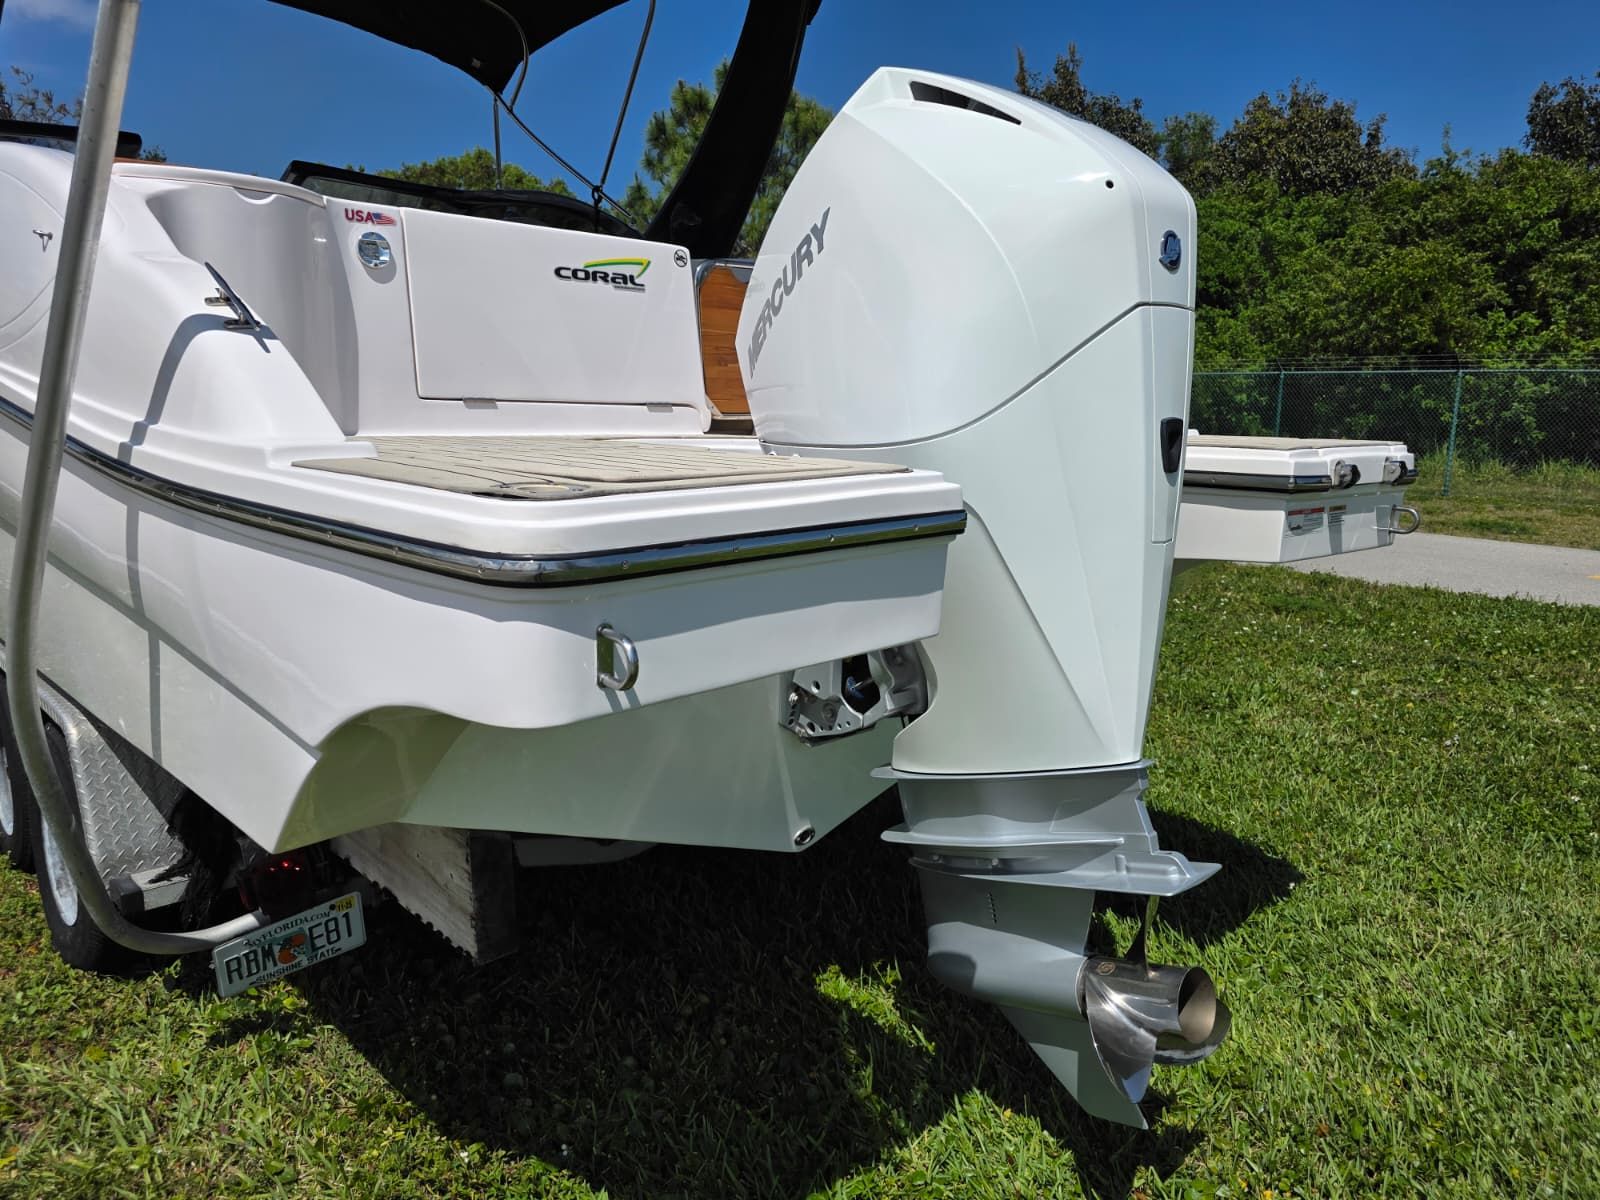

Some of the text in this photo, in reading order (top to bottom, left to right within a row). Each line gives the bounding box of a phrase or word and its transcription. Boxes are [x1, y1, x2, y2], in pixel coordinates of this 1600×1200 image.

[344, 207, 375, 225] USA
[748, 206, 831, 379] MERCURY
[224, 912, 353, 985] RBM E81
[255, 947, 337, 983] SUNSHINE STATE
